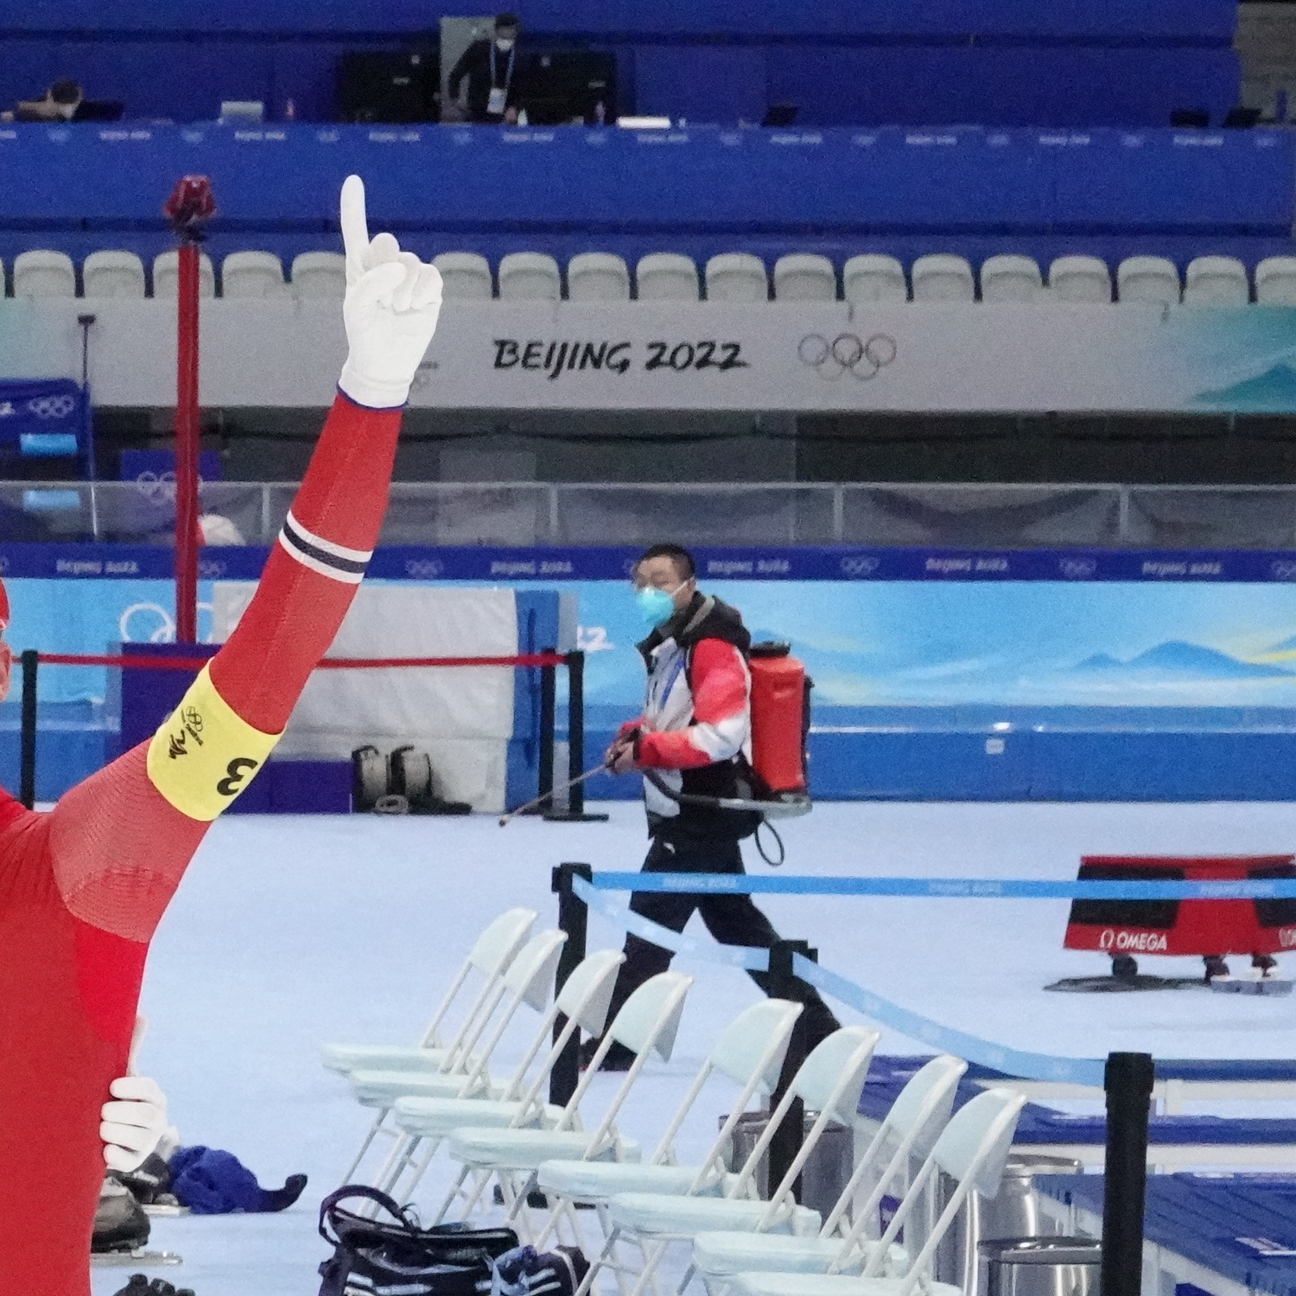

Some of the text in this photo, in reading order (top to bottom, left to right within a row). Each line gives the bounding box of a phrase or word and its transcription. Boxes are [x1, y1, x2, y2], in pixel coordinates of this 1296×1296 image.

[493, 339, 750, 381] BEIJING 2022
[216, 757, 258, 796] 3
[1116, 931, 1168, 951] OMEGA
